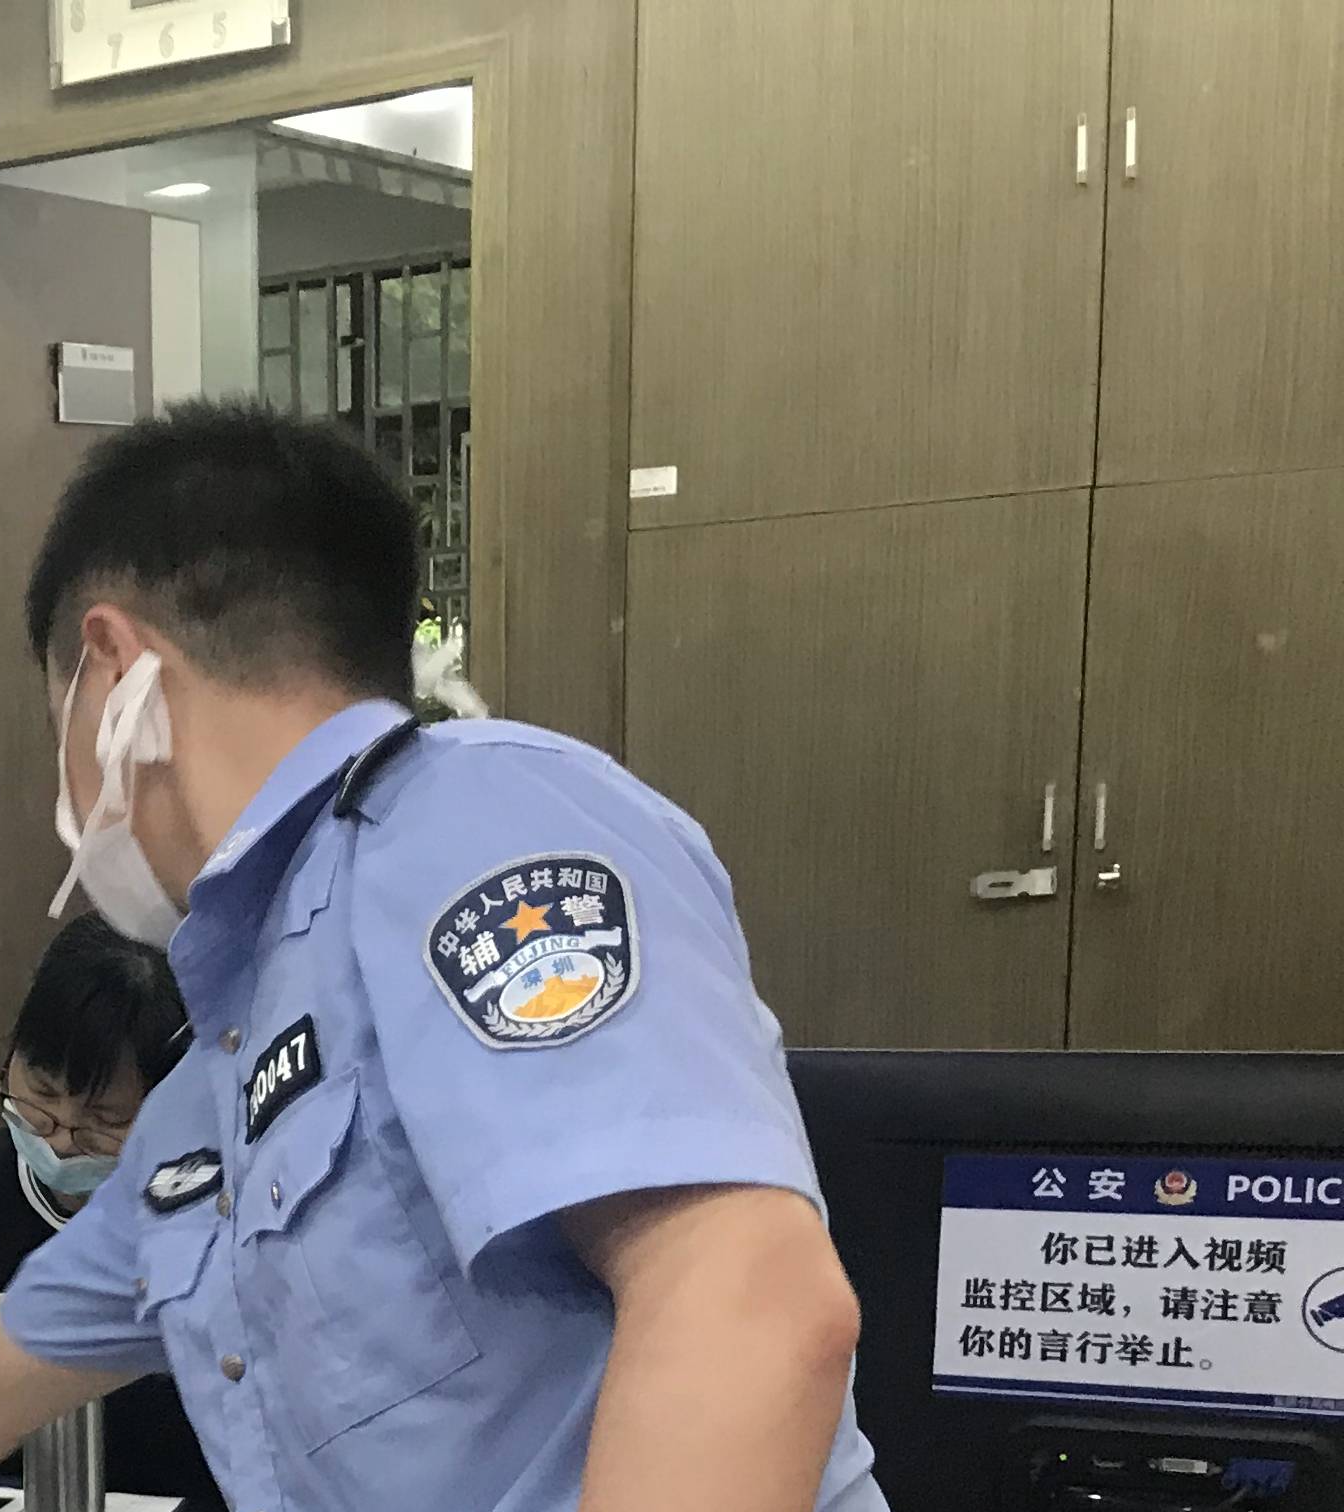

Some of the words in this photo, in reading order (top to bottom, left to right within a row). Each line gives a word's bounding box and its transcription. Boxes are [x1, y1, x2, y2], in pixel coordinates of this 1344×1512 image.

[437, 867, 608, 958] 中华人民共和国
[501, 936, 582, 979] FUJING
[1031, 1167, 1126, 1201] 公安
[1040, 1231, 1288, 1275] 你已进入视频
[960, 1277, 1283, 1325] 监控区域，请注意
